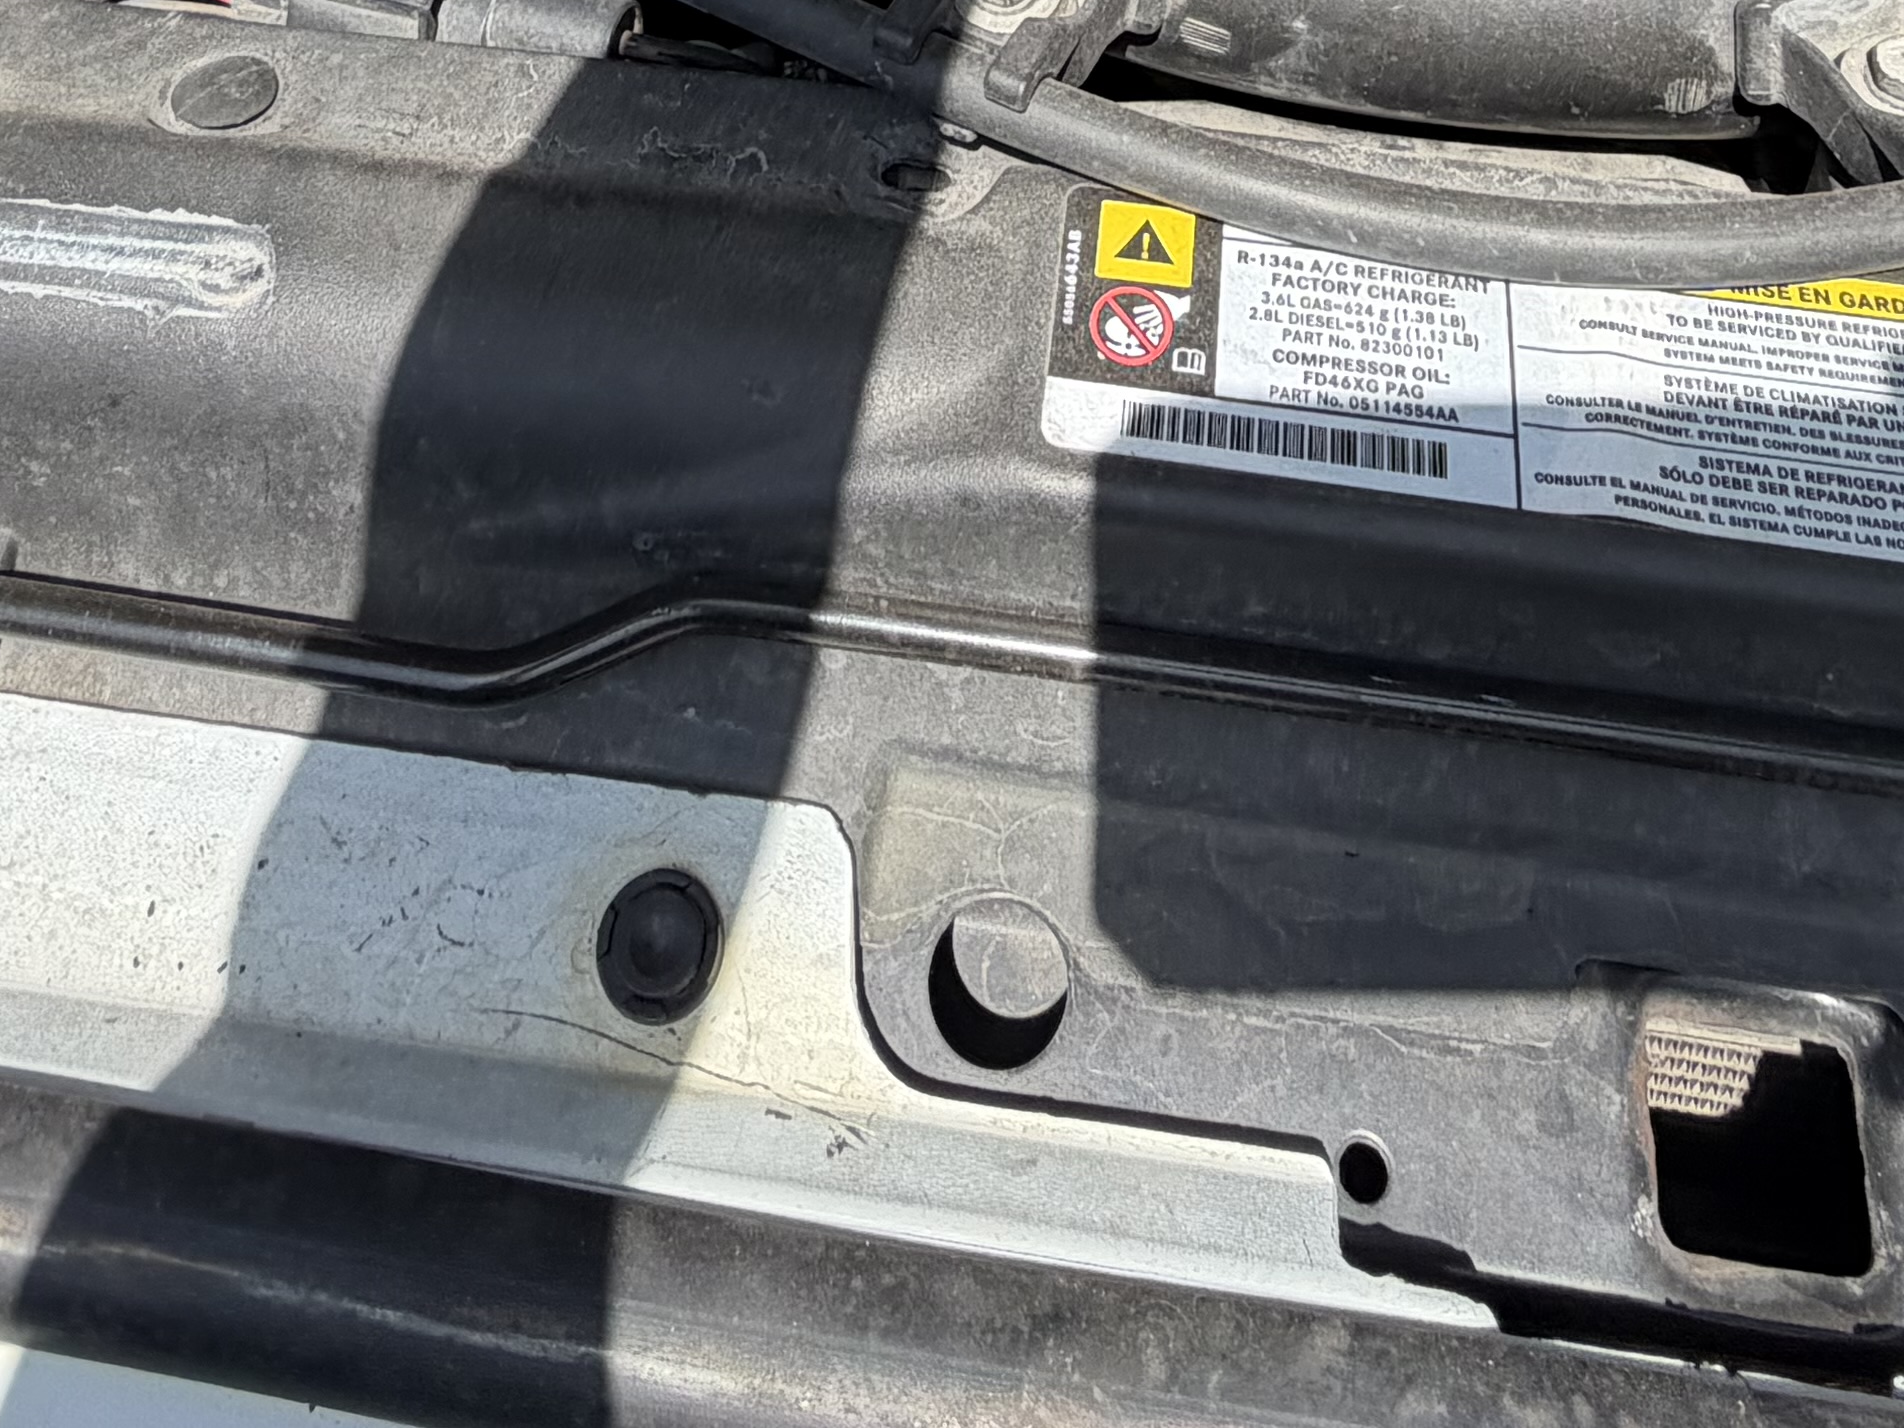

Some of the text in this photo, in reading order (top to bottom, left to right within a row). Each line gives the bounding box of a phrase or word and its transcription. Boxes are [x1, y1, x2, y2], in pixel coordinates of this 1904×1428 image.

[1237, 249, 1491, 294] R-134a A/C REFRIGERANT
[1271, 272, 1456, 309] FACTORY CHARGE:
[1800, 289, 1831, 306] EN
[1249, 307, 1479, 352] 2.8L DIESEL=510 g (1.13 LB)
[1261, 291, 1466, 332] 3.6L GAS=624 g (1.38 LB)
[1666, 313, 1688, 327] TO
[1693, 317, 1714, 331] BE
[1717, 320, 1797, 342] SERVICED
[1802, 330, 1821, 344] BY
[1707, 303, 1837, 331] HIGH-PRESSURE
[1282, 328, 1444, 362] PART No. 82300101
[1578, 319, 1637, 337] CONSULT
[1641, 329, 1694, 346] SERVICE
[1762, 345, 1830, 363] IMPROPER
[1834, 355, 1890, 371] SERVICE
[1663, 348, 1715, 363] SYSTEM
[1719, 354, 1763, 370] MEETS
[1766, 361, 1815, 377] SAFETY
[1272, 348, 1450, 385] COMPRESSOR OIL:
[1303, 370, 1425, 400] FD46XG PAG
[1269, 385, 1311, 404] PART
[1316, 391, 1343, 409] No.
[1663, 373, 1738, 395] SYSTÈME
[1743, 384, 1766, 399] DE
[1769, 388, 1896, 415] CLIMATISATION
[1663, 391, 1728, 412] DEVANT
[1733, 395, 1774, 416] ÊTRE
[1778, 403, 1841, 425] RÉPARÉ
[1846, 414, 1880, 431] PAR
[1546, 394, 1623, 411] CONSULTER
[1627, 400, 1642, 413] LE
[1646, 405, 1698, 424] MANUEL
[1799, 425, 1826, 440] DES
[1698, 429, 1759, 448] SYSTÈME
[1763, 438, 1840, 459] CONFORME
[1844, 449, 1873, 462] AUX
[1659, 464, 1704, 485] SÓLO
[1709, 474, 1753, 491] DEBE
[1758, 481, 1790, 497] SER
[1795, 485, 1887, 511] REPARADO
[1699, 456, 1773, 479] SISTEMA
[1777, 465, 1800, 482] DE
[1534, 471, 1607, 488] CONSULTE
[1610, 477, 1626, 490] EL
[1630, 480, 1686, 502] MANUAL
[1690, 493, 1708, 505] DE
[1784, 504, 1852, 525] MÉTODOS
[1708, 513, 1725, 525] EL
[1729, 516, 1790, 534] SISTEMA
[1793, 524, 1852, 543] CUMPLE
[1855, 532, 1882, 547] LAS
